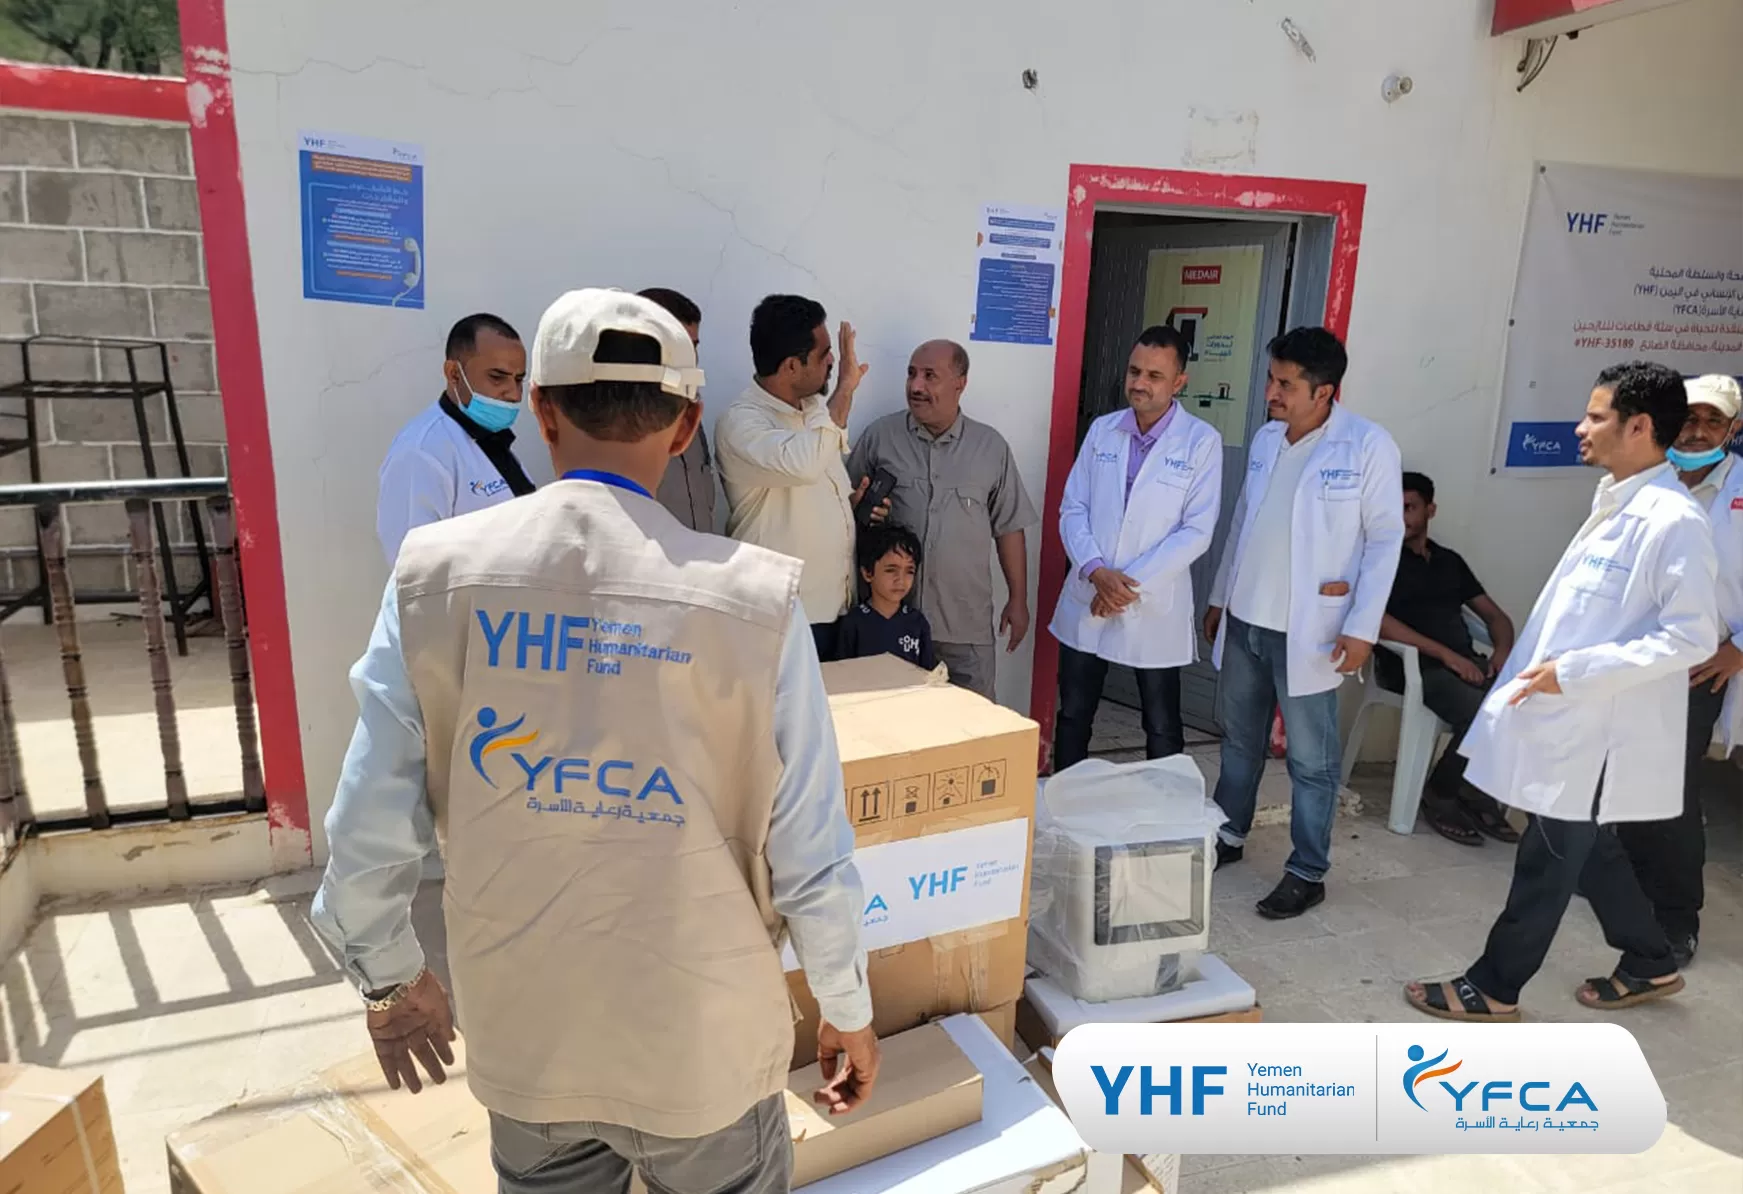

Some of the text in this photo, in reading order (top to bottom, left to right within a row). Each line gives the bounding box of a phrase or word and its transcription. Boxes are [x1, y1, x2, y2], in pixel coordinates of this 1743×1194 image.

[1567, 212, 1608, 233] YHF
[1532, 441, 1561, 451] YFCA
[1320, 468, 1340, 479] YHF
[591, 617, 642, 637] Yemen
[476, 610, 590, 671] YHF
[588, 639, 692, 664] Humanitarian
[587, 658, 621, 675] Fund
[511, 753, 684, 804] YFCA
[573, 800, 624, 819] رعاية
[622, 804, 685, 827] جمعية
[909, 866, 968, 900] YHF
